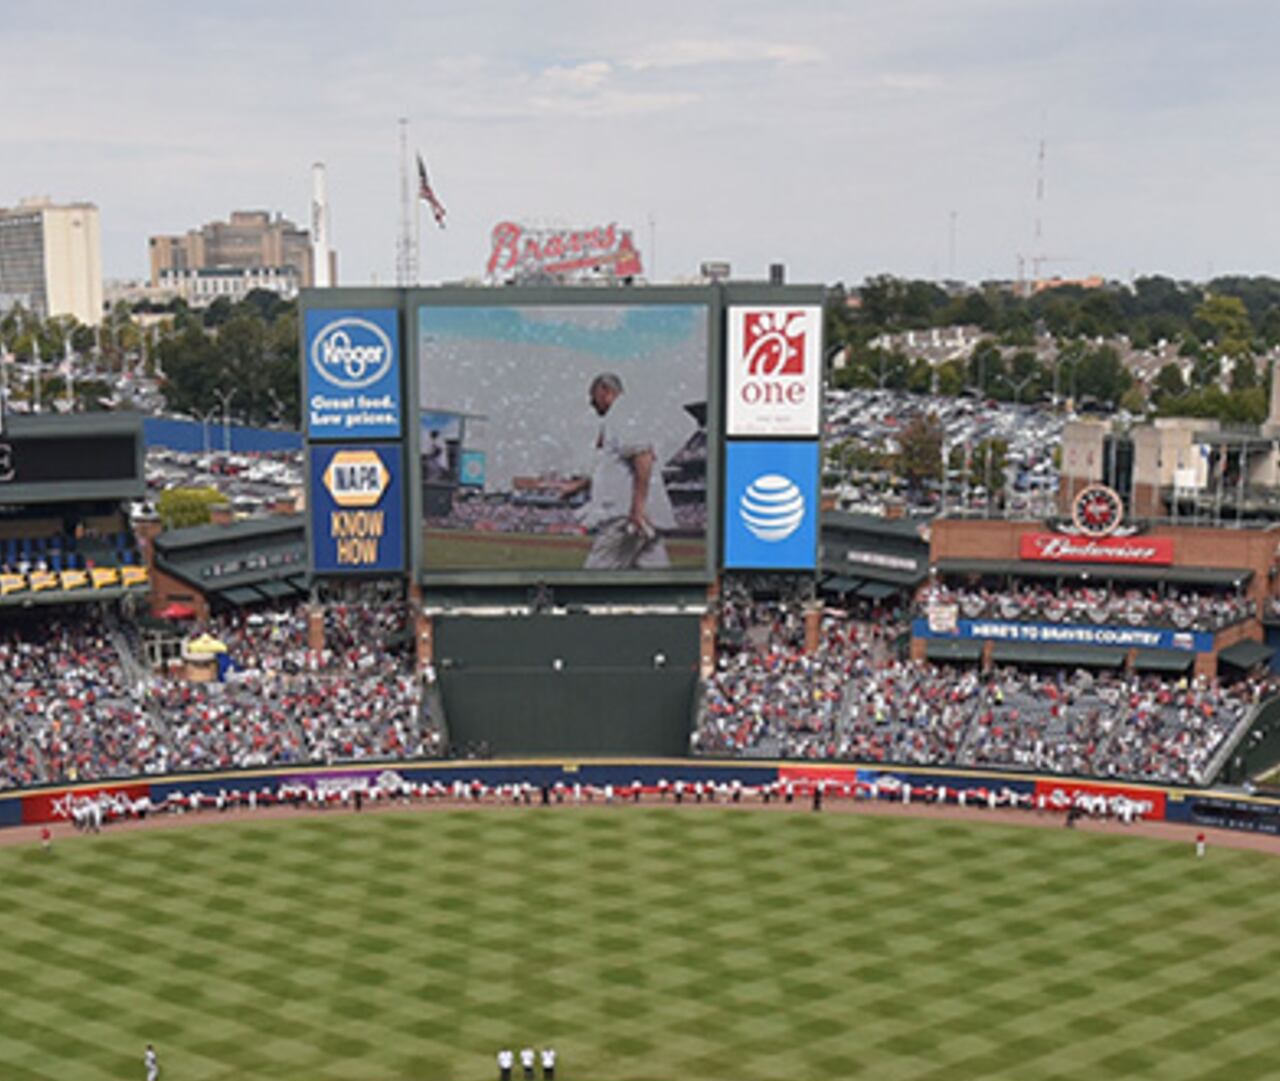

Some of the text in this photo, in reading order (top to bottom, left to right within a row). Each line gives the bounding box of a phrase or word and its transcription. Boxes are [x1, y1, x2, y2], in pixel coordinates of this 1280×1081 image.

[486, 221, 617, 273] Braves
[323, 330, 384, 378] Kroger
[311, 395, 396, 410] Great food.
[742, 382, 806, 404] one
[311, 411, 397, 428] Low prices.
[334, 466, 380, 491] NAPA
[331, 511, 384, 538] KNOW
[337, 539, 378, 565] HOW
[1034, 538, 1157, 560] Budweiser
[972, 624, 1161, 646] HERE'S TO BRAVES COUNTRY
